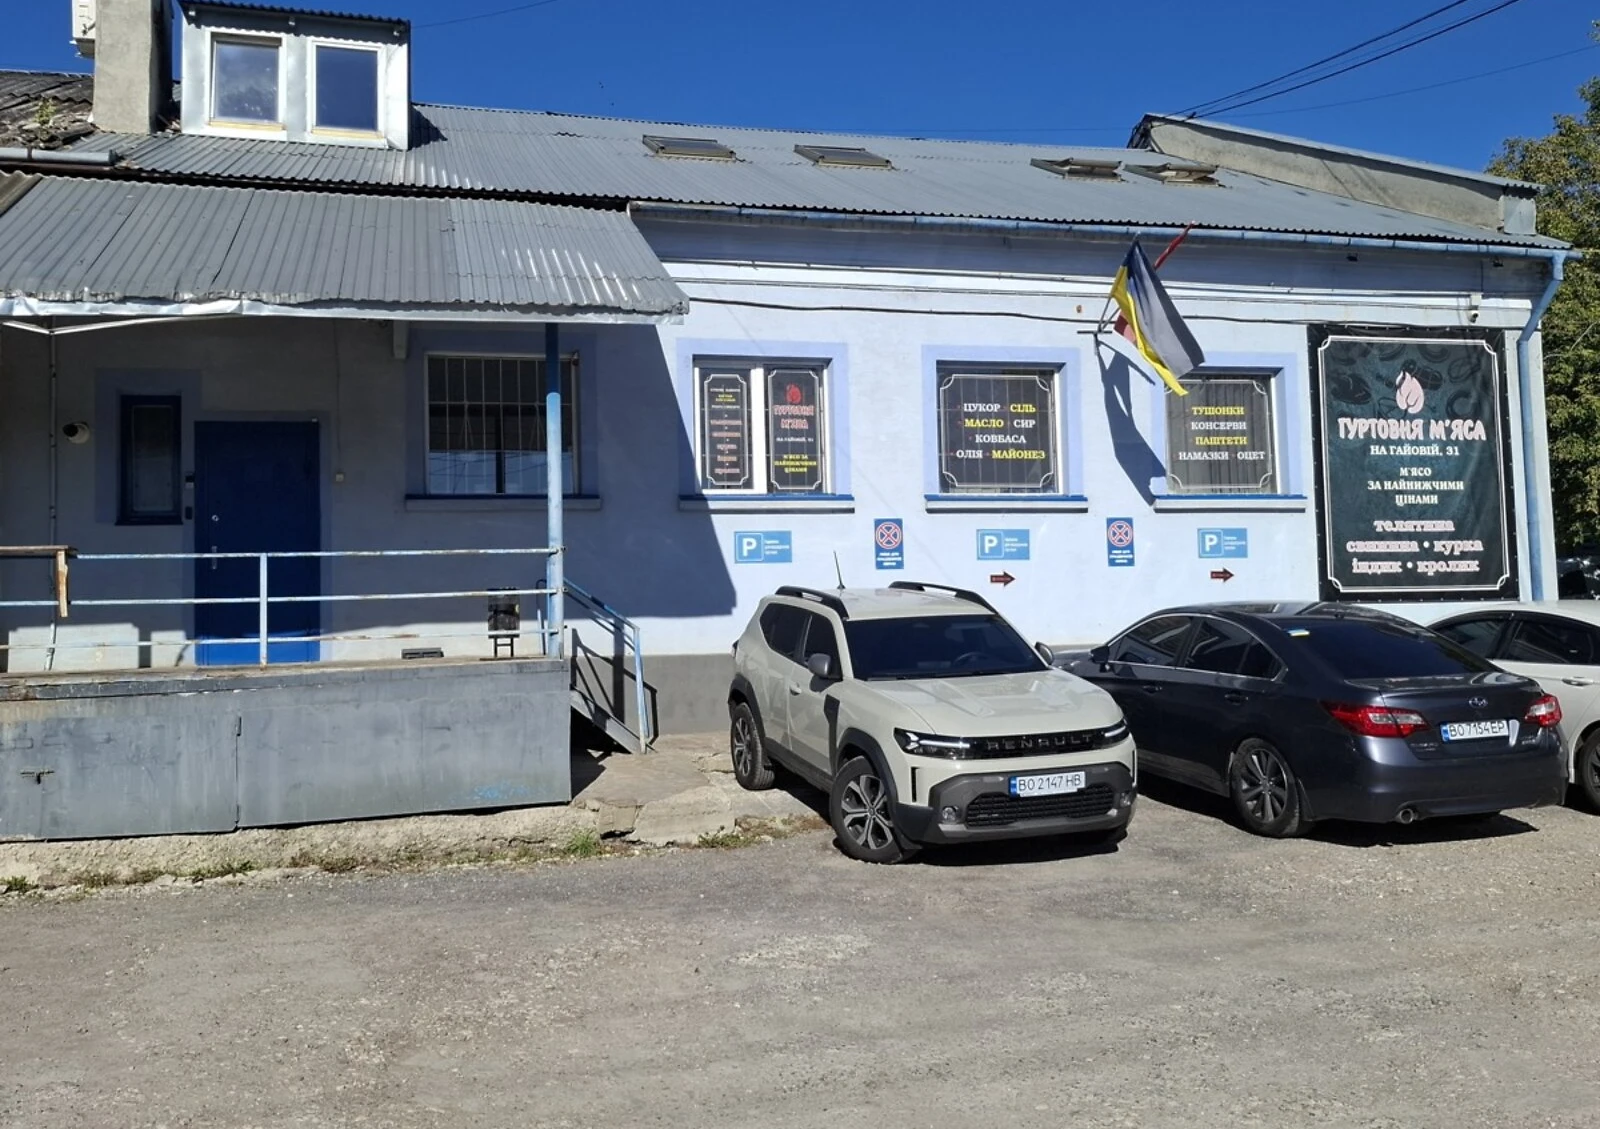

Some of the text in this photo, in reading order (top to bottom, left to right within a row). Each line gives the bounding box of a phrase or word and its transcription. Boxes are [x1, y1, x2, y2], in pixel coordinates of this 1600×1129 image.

[963, 403, 1036, 413] ЦУКОР СІЛЬ
[1191, 406, 1245, 415] ТУШОНКИ
[964, 418, 1036, 428] МАСЛО СИР
[1191, 421, 1247, 430] КОНСЕРВИ
[1337, 417, 1487, 441] ГУРТОВНЯ М'ЯСА
[975, 434, 1027, 444] КОВБАСА
[1195, 436, 1248, 446] ПАШТЕТИ
[956, 448, 1046, 459] ОЛІЯ МАЙОНЕЗ
[1178, 451, 1266, 460] НАМАЗКИ ОЦЕТ
[1370, 445, 1387, 455] НА
[1446, 445, 1460, 456] 31
[1367, 479, 1464, 491] ЗА НАЙНИЖЧИМИ
[1395, 494, 1438, 507] ЦІНАМИ
[742, 537, 757, 557] P
[984, 535, 998, 553] P
[1205, 534, 1218, 552] P
[1433, 539, 1484, 556] курка
[986, 733, 1093, 750] RENAULT
[1018, 773, 1082, 791] BO 2147 HB
